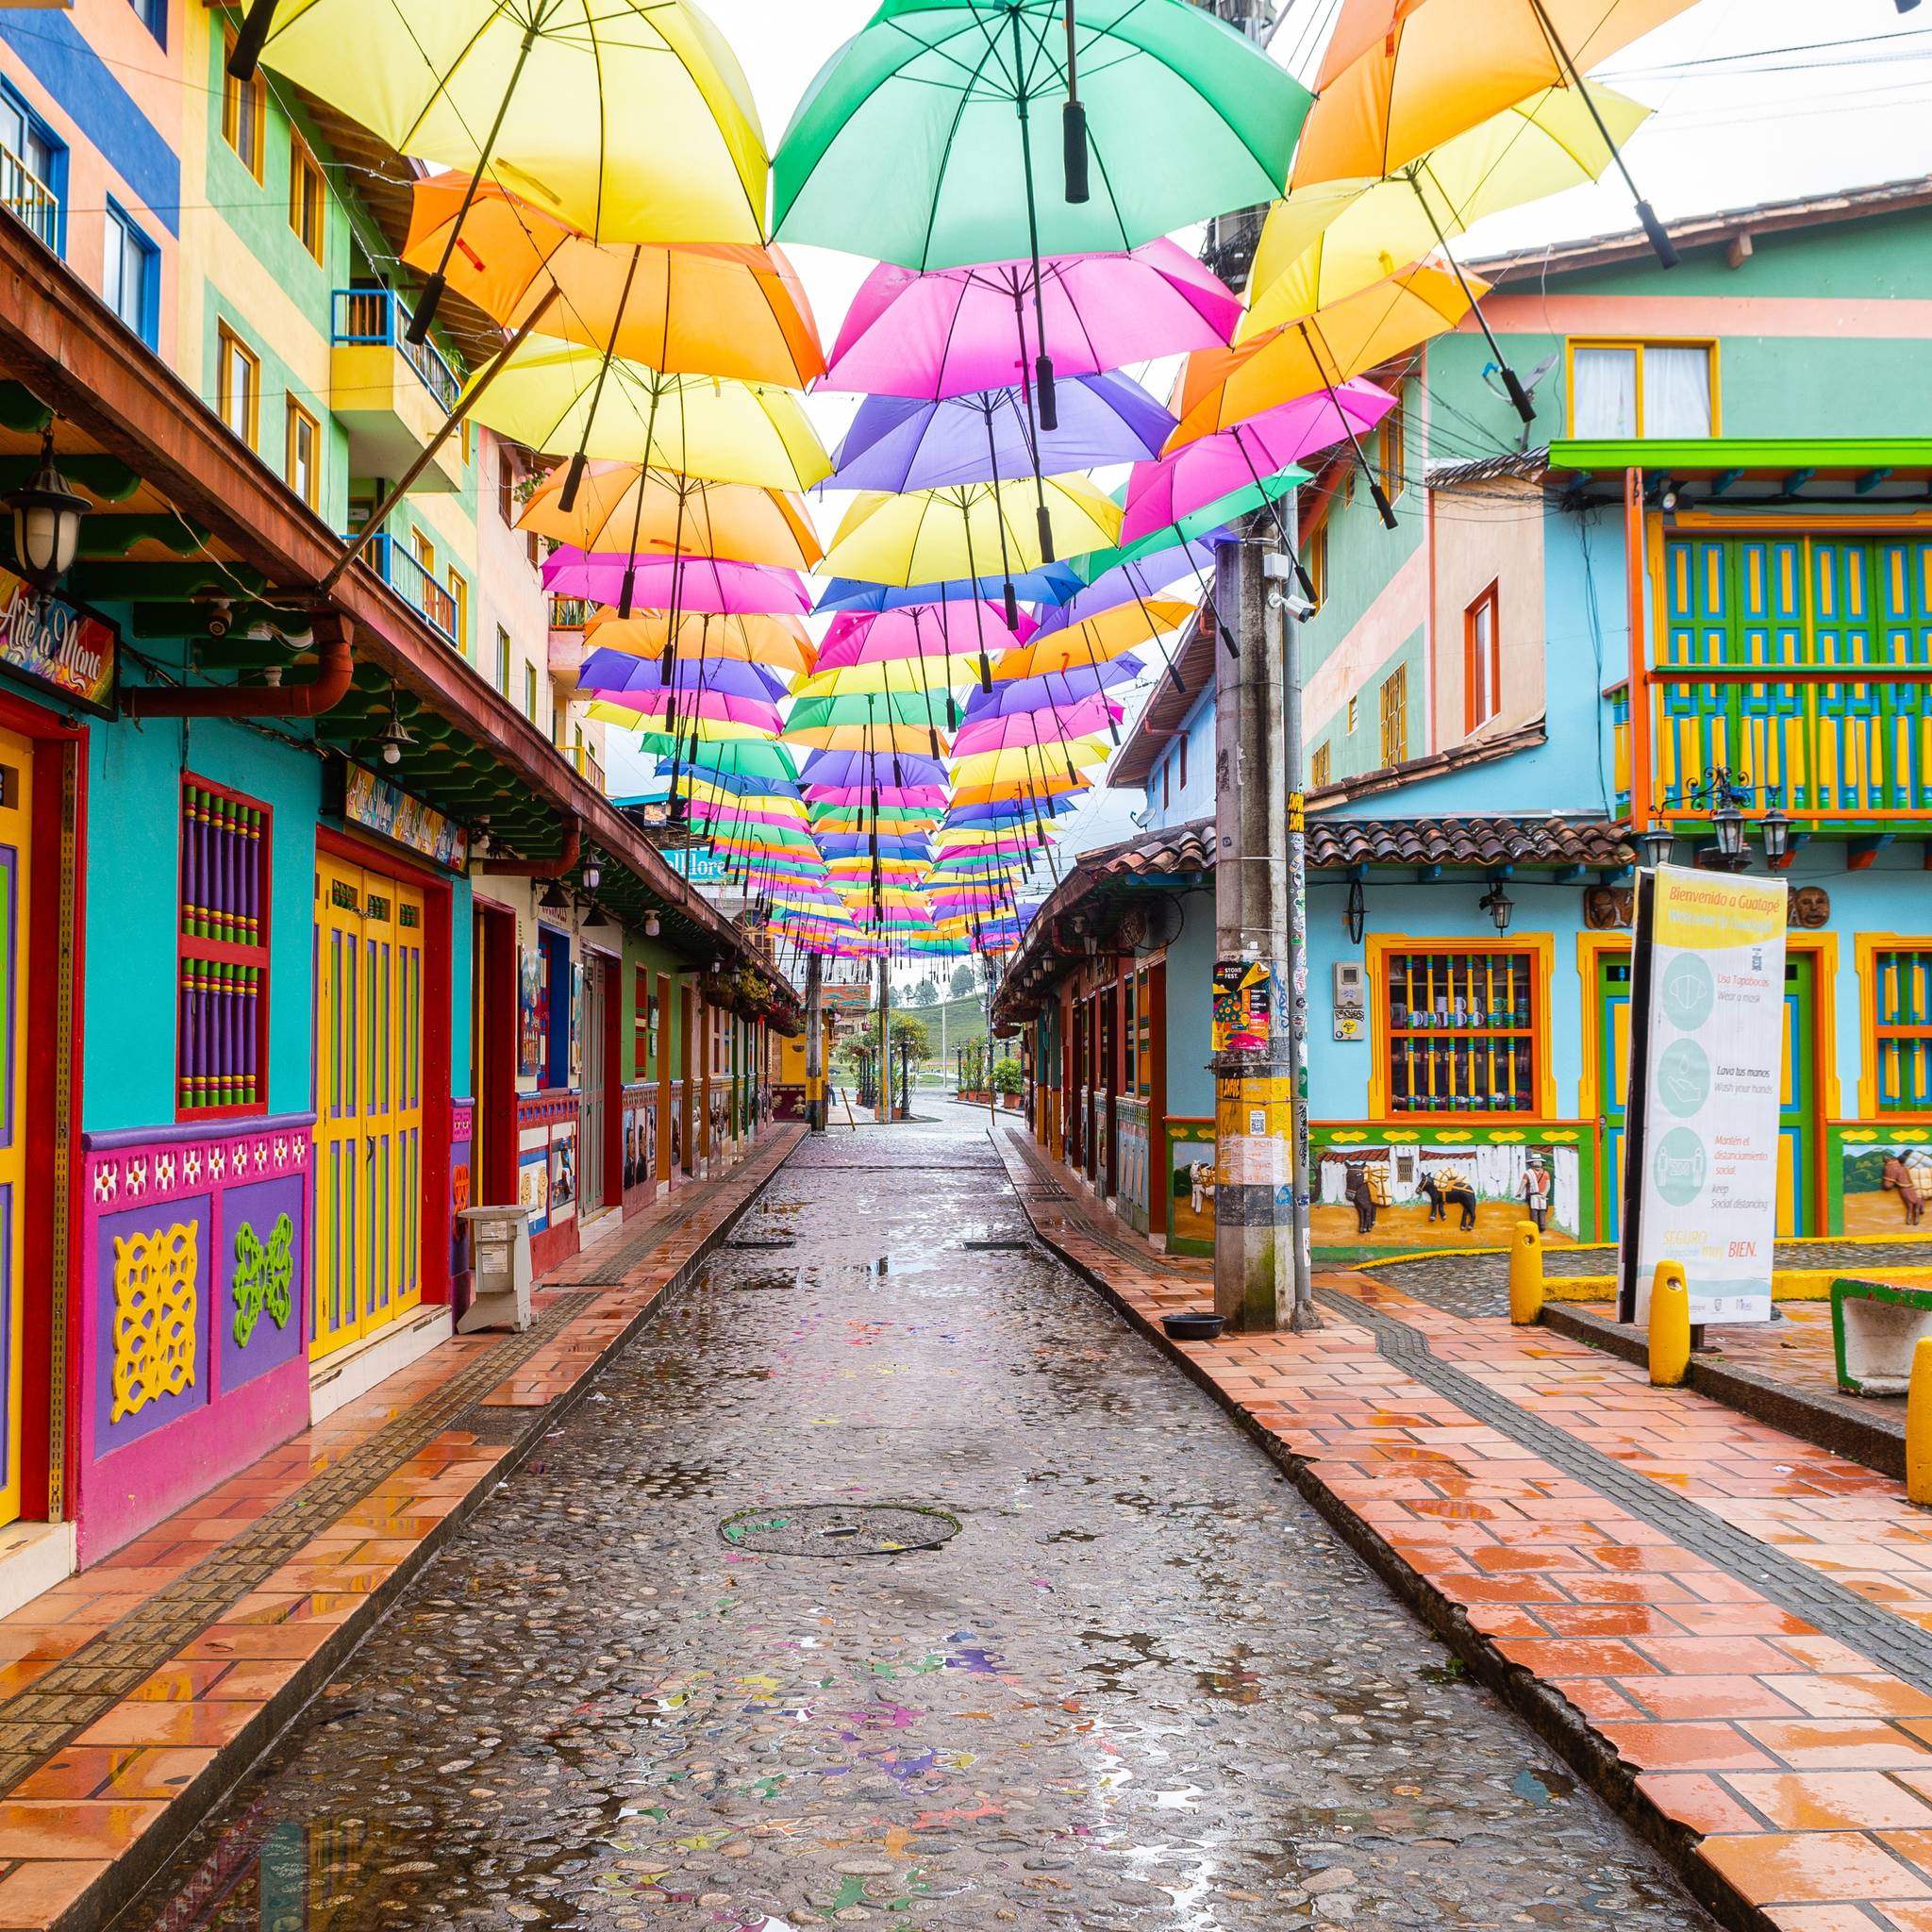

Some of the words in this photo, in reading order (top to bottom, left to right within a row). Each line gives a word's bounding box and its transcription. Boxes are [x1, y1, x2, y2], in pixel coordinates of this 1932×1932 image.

[661, 851, 726, 876] ollore
[1669, 886, 1727, 907] Bienvenido
[1729, 896, 1736, 908] a
[1739, 895, 1780, 915] Guatapé
[1717, 1066, 1735, 1075] Lava
[1736, 1067, 1746, 1076] tus
[1747, 1069, 1771, 1077] manos
[1727, 1241, 1757, 1258] BIEN.
